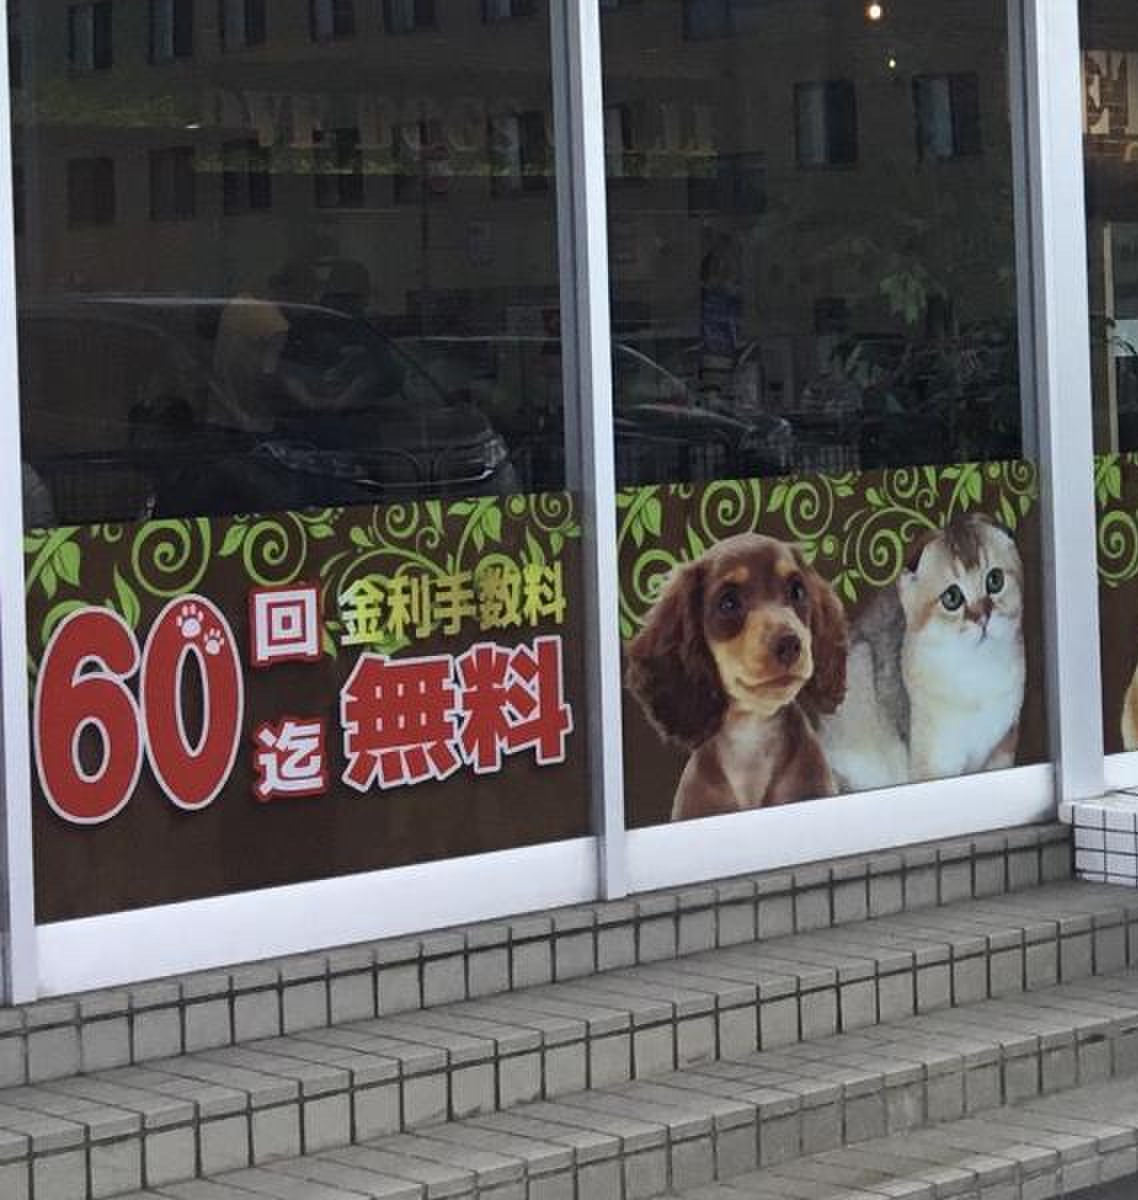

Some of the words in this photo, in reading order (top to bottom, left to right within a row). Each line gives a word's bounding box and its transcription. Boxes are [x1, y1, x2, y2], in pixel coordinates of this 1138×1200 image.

[340, 560, 568, 647] 金利手数料
[34, 593, 244, 825] 60
[340, 635, 574, 793] 無料
